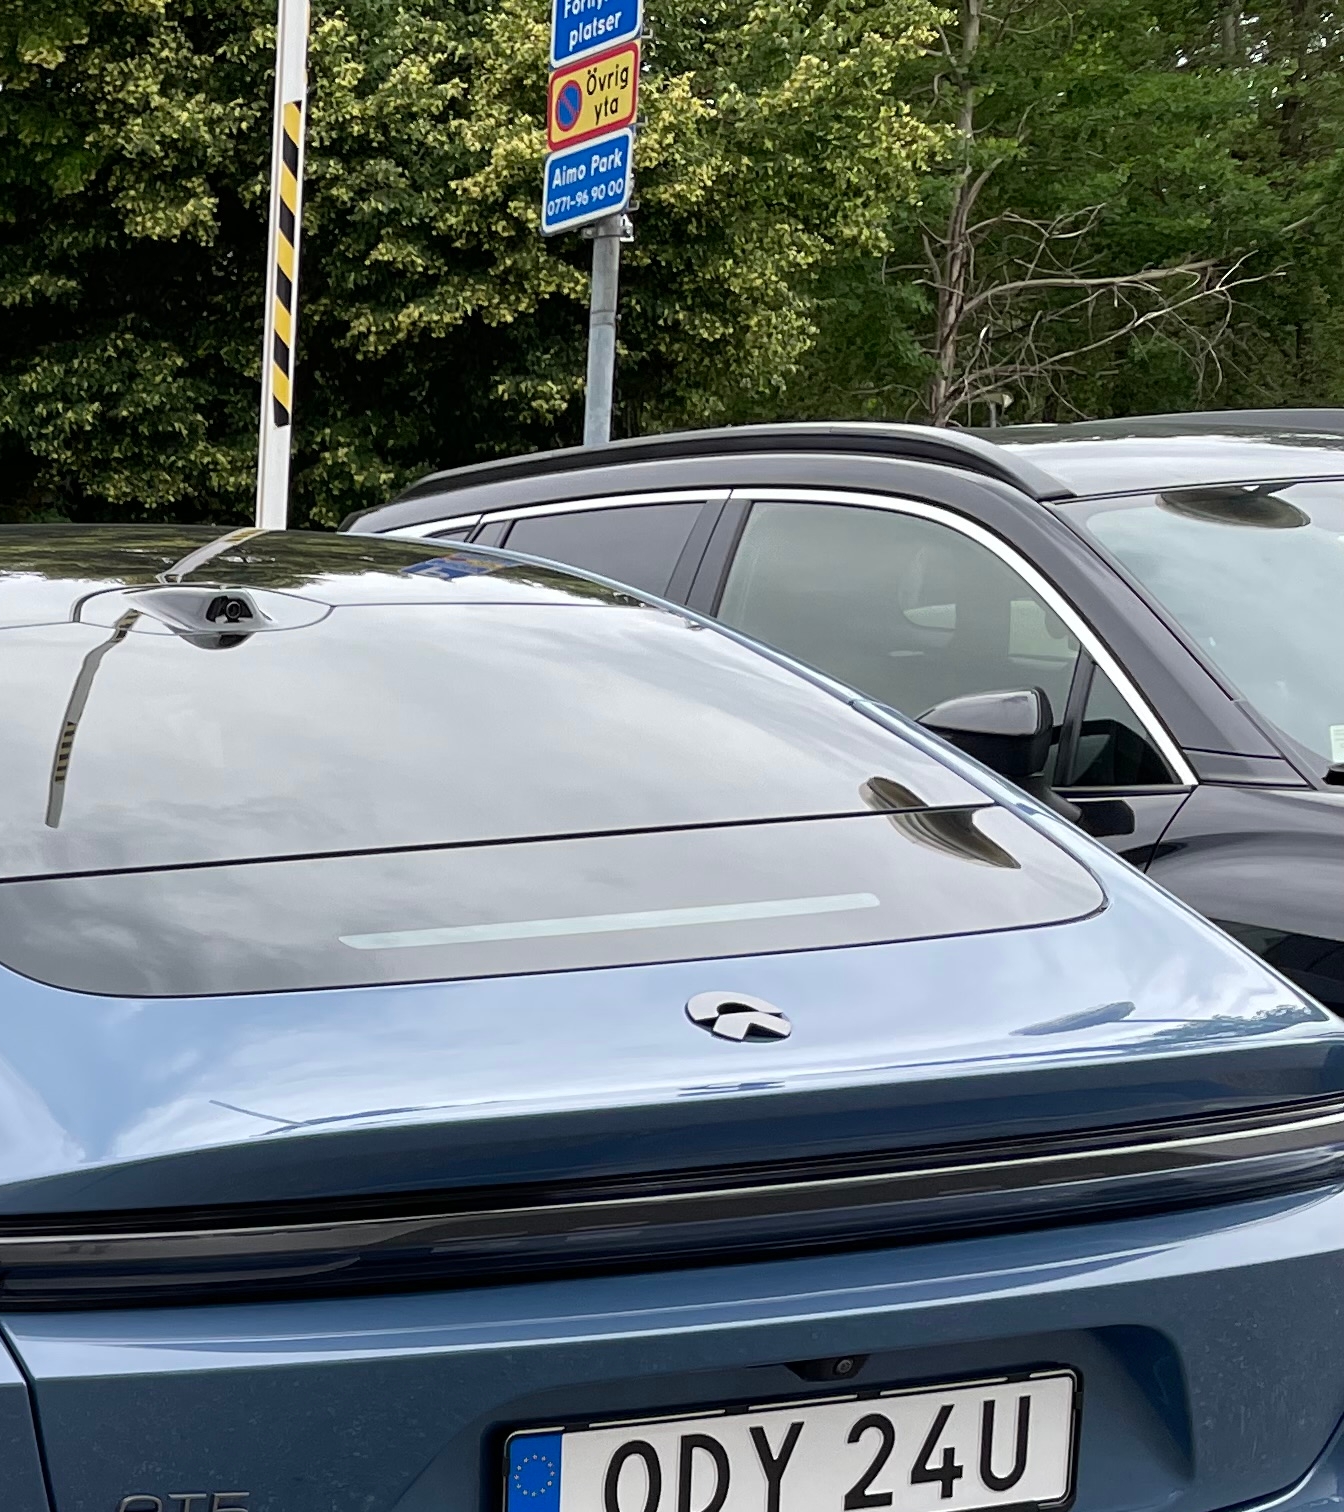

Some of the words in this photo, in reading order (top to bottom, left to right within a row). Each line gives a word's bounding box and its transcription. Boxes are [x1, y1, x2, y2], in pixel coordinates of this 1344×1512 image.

[569, 11, 623, 52] platser
[586, 64, 629, 95] Övrig
[594, 96, 619, 125] yta
[552, 164, 586, 189] Aimo
[591, 148, 623, 176] Park
[547, 189, 590, 216] 0771-96
[591, 183, 606, 200] 90
[607, 178, 624, 195] 00
[843, 1395, 1031, 1511] 24U
